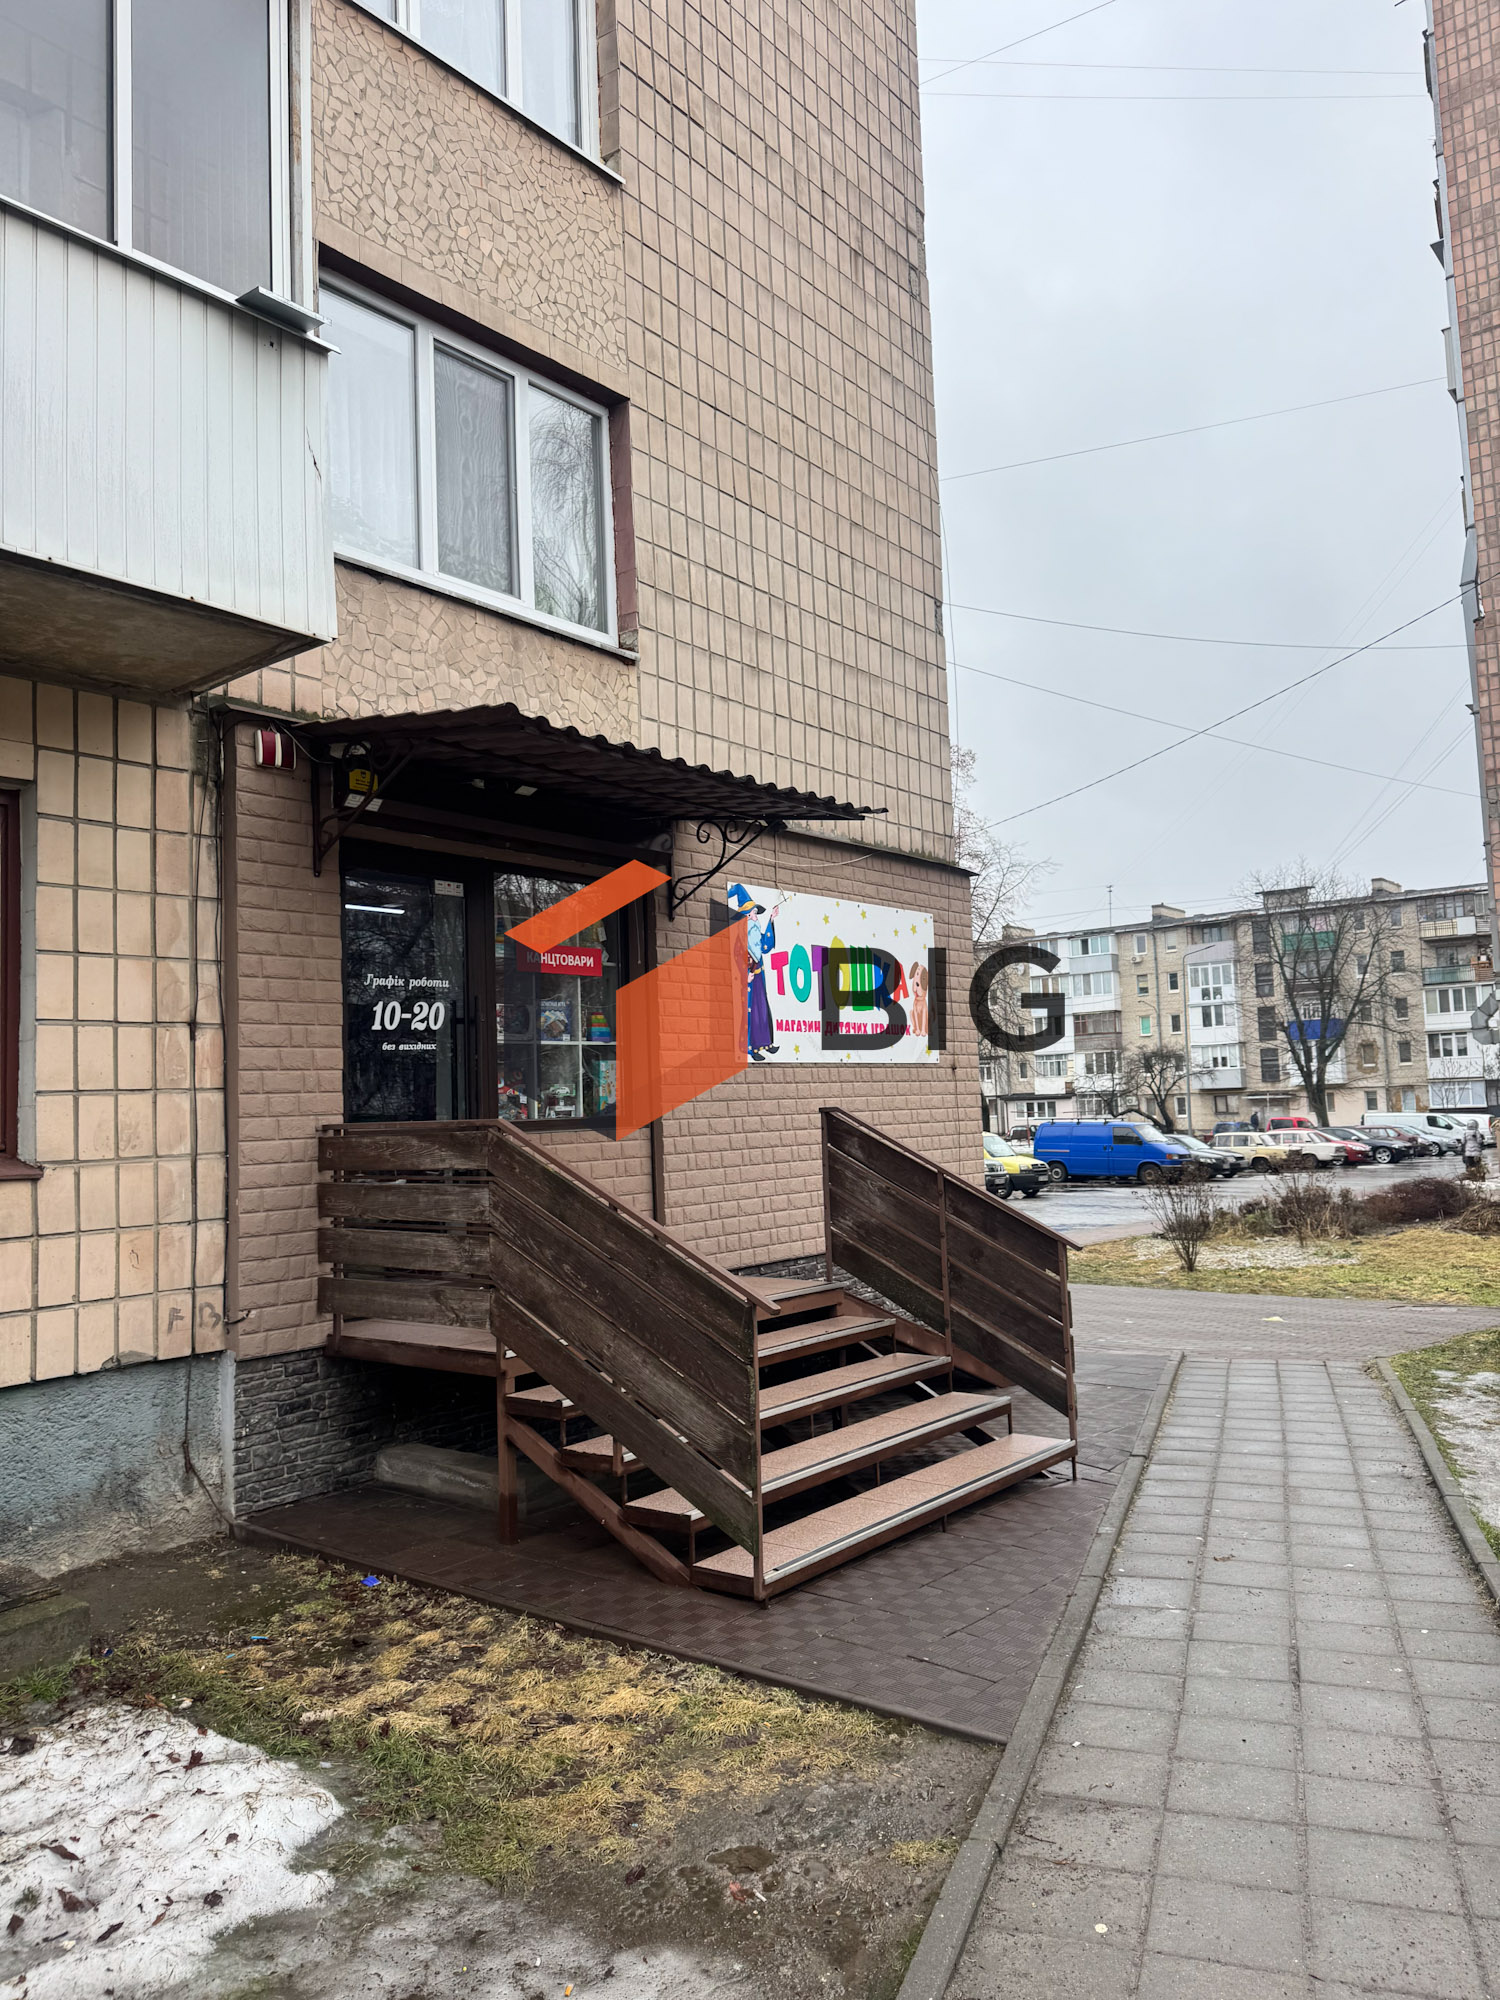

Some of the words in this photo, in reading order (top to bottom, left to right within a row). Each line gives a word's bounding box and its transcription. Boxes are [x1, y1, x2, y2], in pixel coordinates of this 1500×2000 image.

[526, 951, 594, 968] КАНЦТОВАРИ
[364, 973, 405, 989] Графік
[409, 976, 450, 990] роботи
[770, 935, 909, 1011] ТОТОШКА
[371, 1000, 445, 1031] 10-20
[776, 1019, 821, 1033] МАГАЗИН
[824, 1021, 868, 1036] ДИТЯЧИХ
[871, 1021, 911, 1036] ІГРАШОК
[382, 1041, 396, 1051] без
[399, 1042, 437, 1051] вихідних
